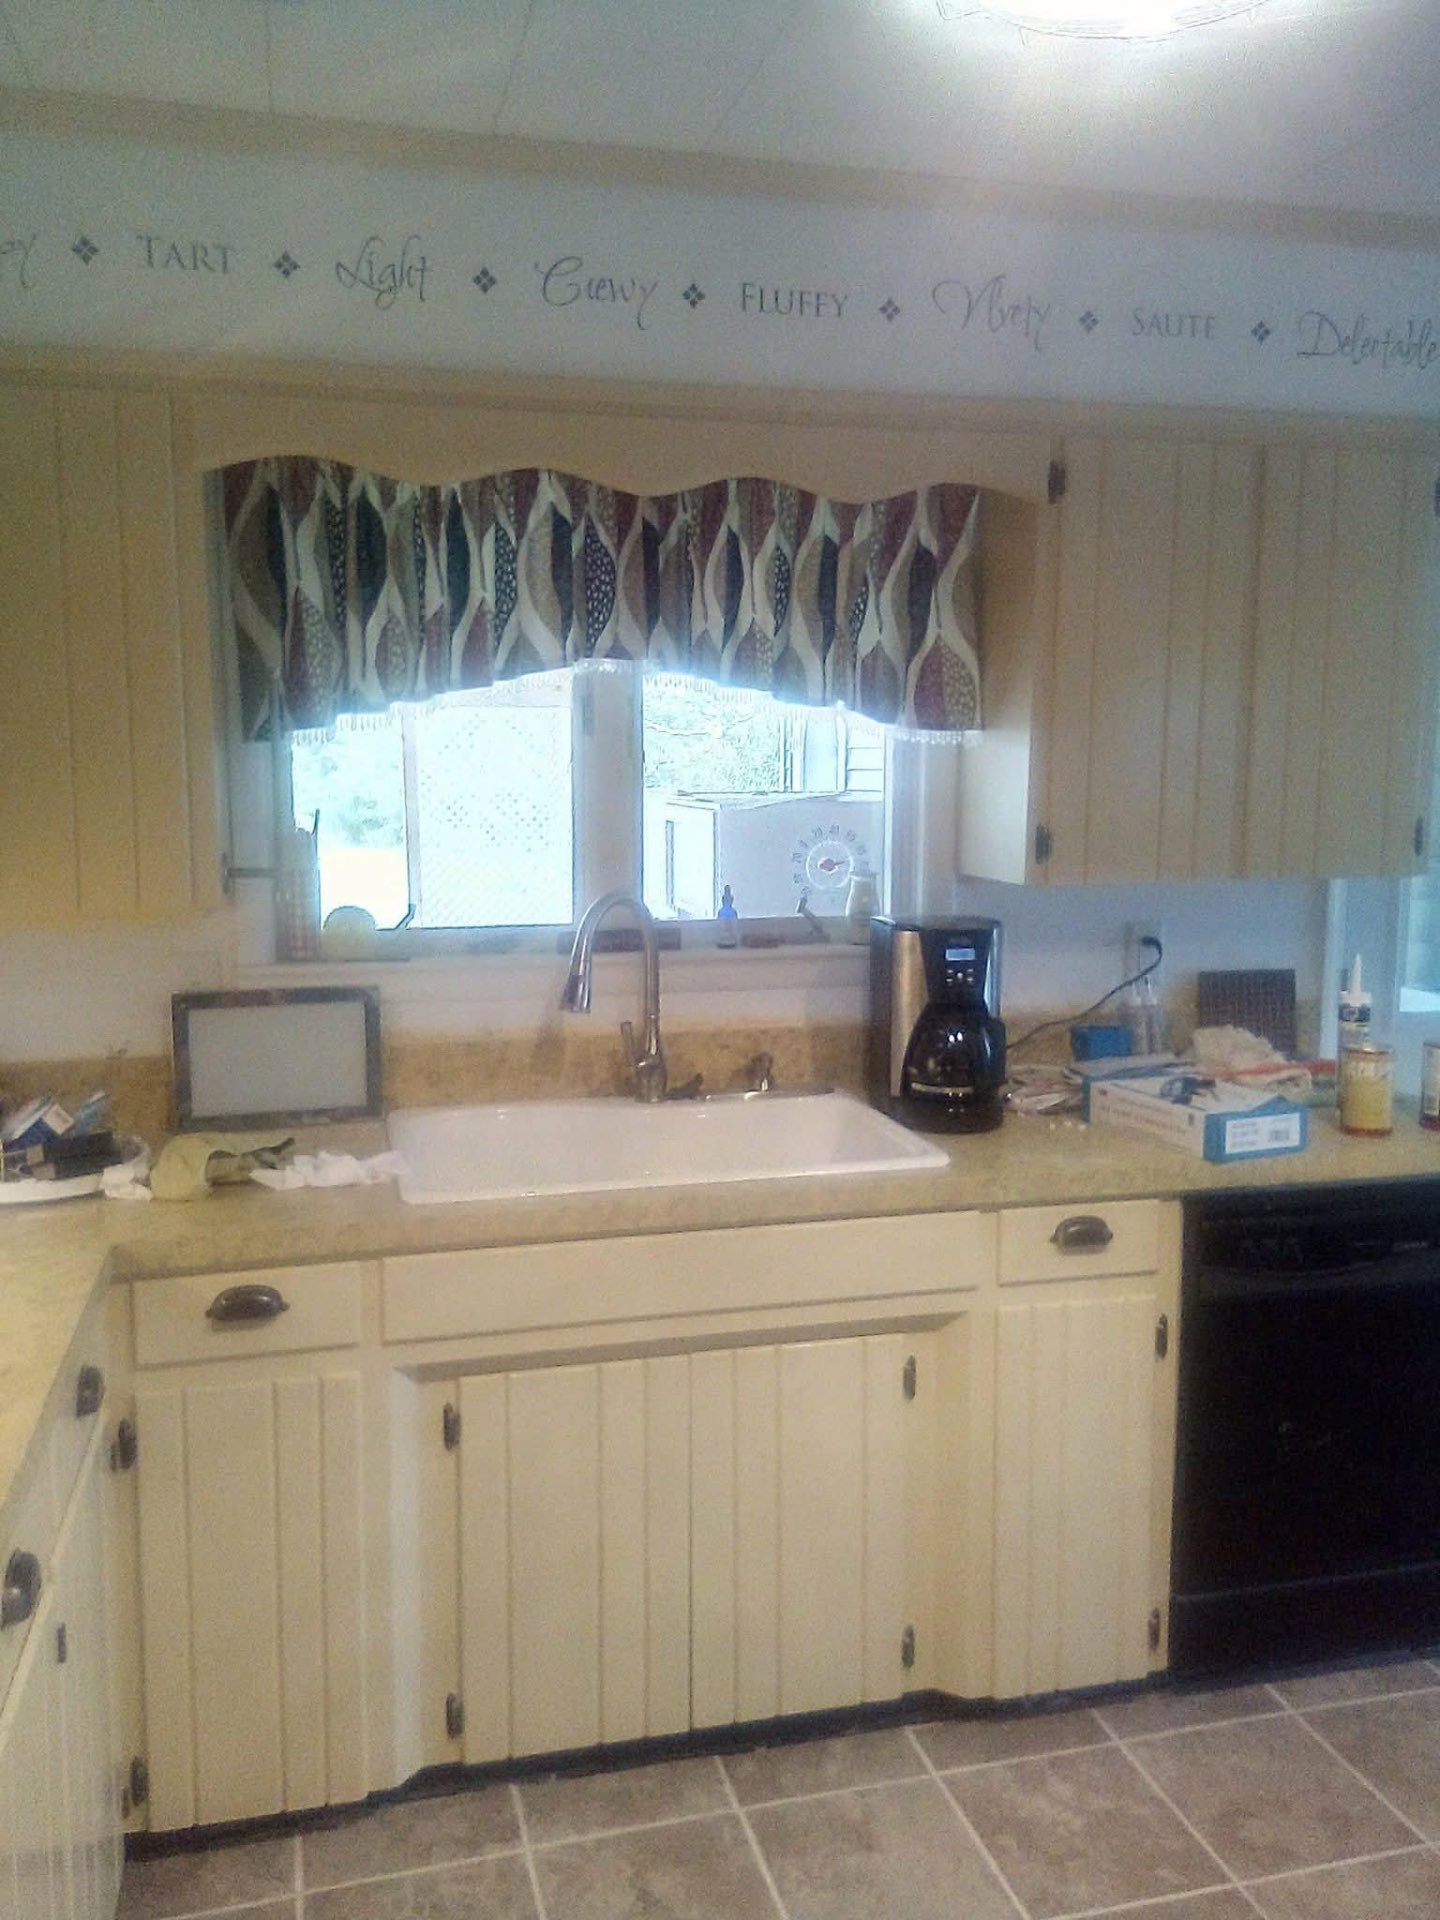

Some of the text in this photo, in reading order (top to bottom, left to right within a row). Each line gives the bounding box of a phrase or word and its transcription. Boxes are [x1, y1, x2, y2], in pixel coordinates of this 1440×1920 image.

[136, 235, 235, 275] TART
[335, 234, 434, 312] Light
[741, 282, 849, 319] FLUFFY
[1132, 307, 1217, 340] SAUTE
